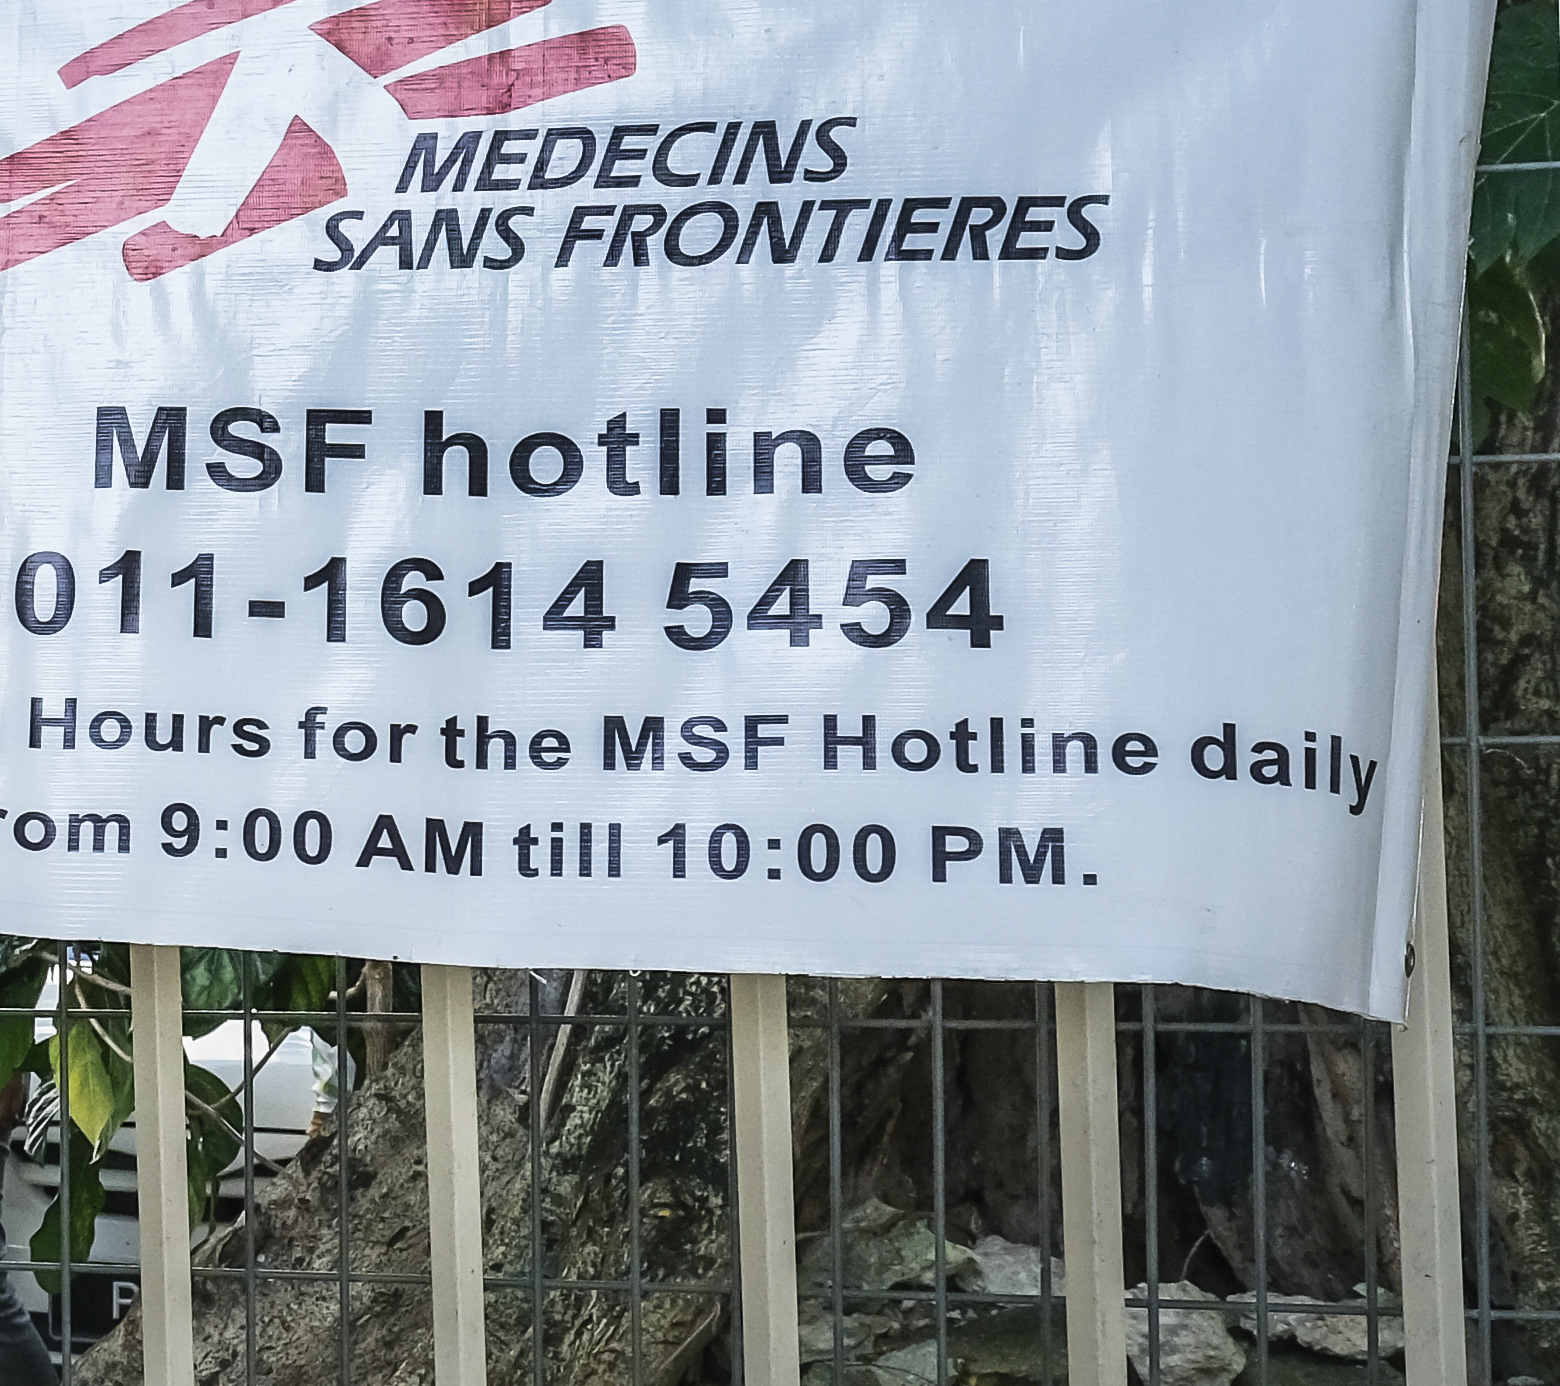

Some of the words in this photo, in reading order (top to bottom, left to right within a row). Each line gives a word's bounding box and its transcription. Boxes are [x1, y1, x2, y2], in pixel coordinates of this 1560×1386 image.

[393, 120, 858, 194] MEDECINS
[312, 205, 536, 274] SANS
[554, 194, 1110, 270] FRONTIERES
[94, 406, 373, 494] MSF
[422, 407, 916, 498] hotline
[14, 550, 617, 650] 011-1614
[663, 558, 1005, 652] 5454
[28, 696, 271, 758] Hours
[298, 705, 419, 764] for
[439, 715, 573, 771] the
[602, 715, 790, 773] MSF
[823, 715, 1159, 777] Hotline
[1190, 722, 1378, 817] daily
[160, 802, 334, 867] 9:00
[354, 814, 484, 878] AM
[512, 821, 622, 879] till
[656, 822, 898, 885] 10:00
[931, 825, 1098, 887] PM.
